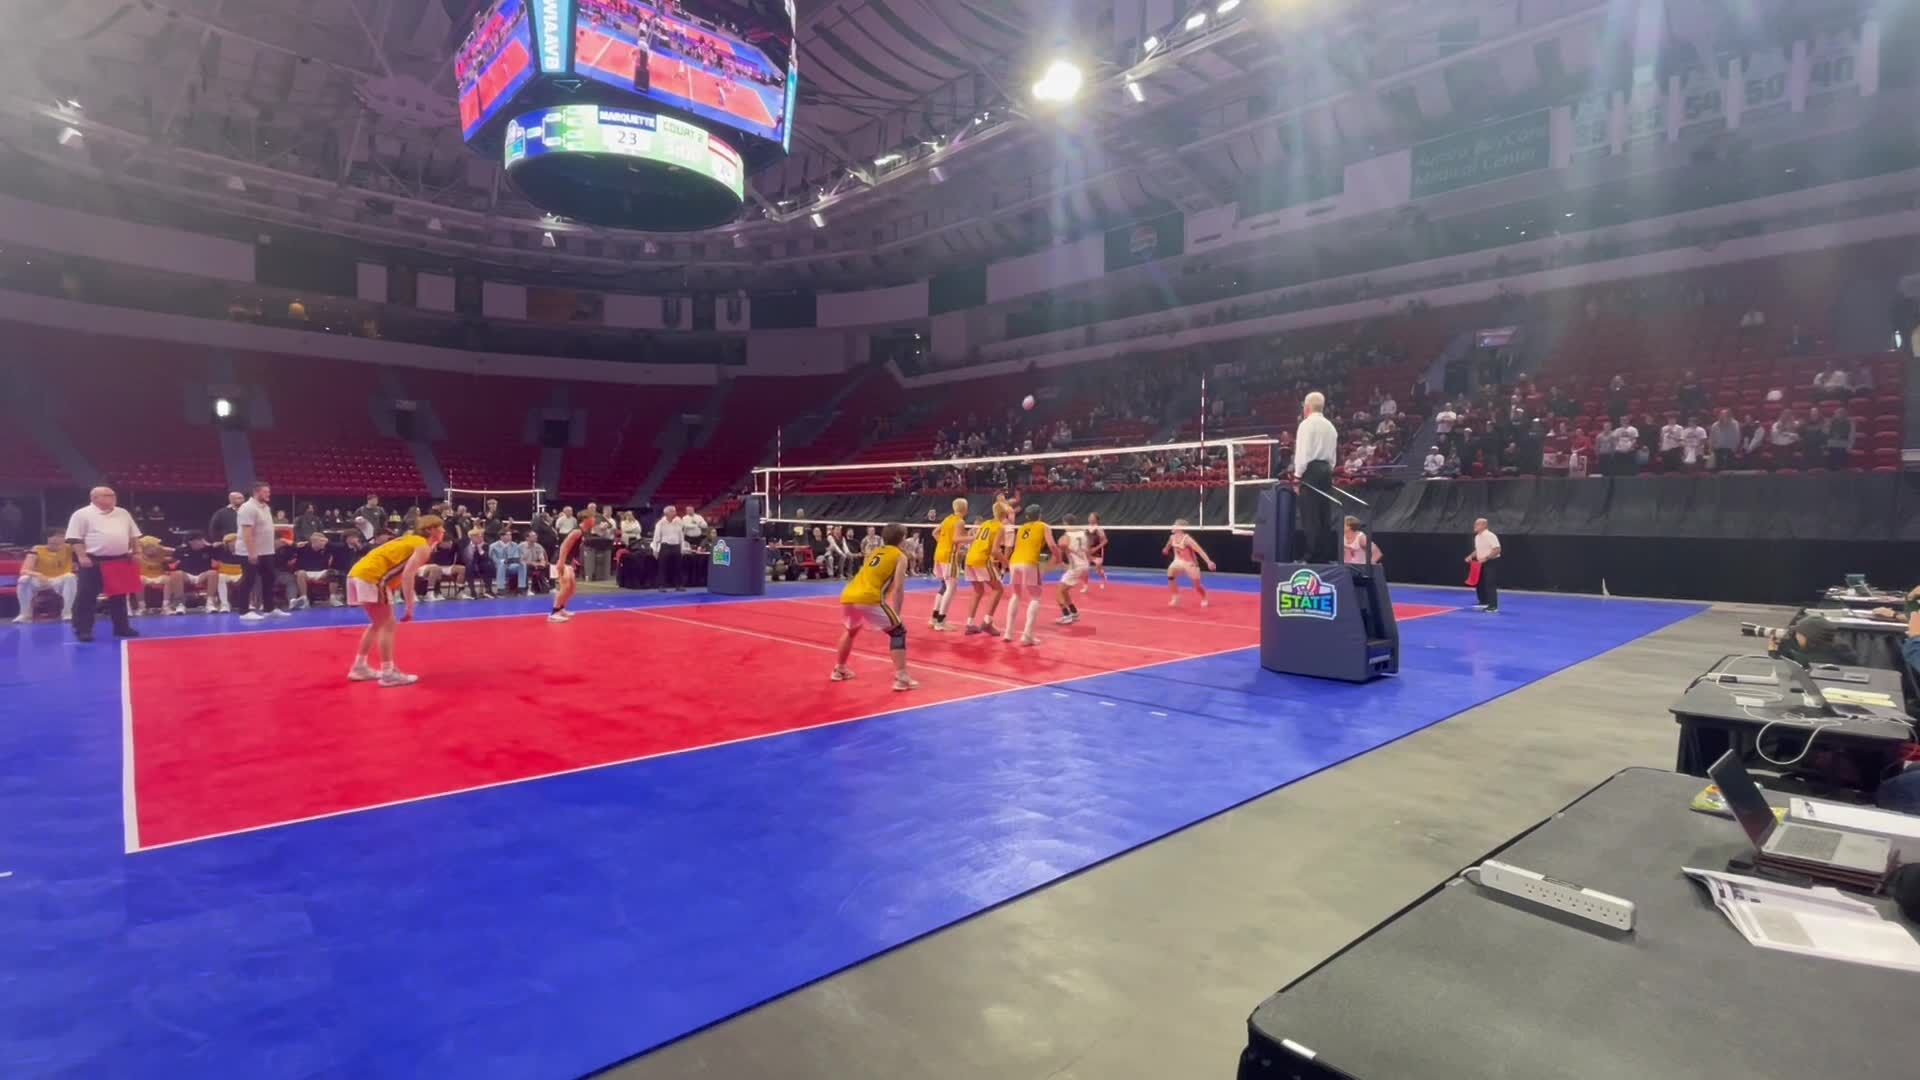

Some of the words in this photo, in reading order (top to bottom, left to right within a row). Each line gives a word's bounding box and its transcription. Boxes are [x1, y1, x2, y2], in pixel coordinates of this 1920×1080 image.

[600, 111, 655, 128] MARQUETTE
[617, 130, 637, 145] 23
[663, 120, 695, 140] COURT
[975, 527, 990, 540] 10
[1281, 593, 1332, 610] STATE
